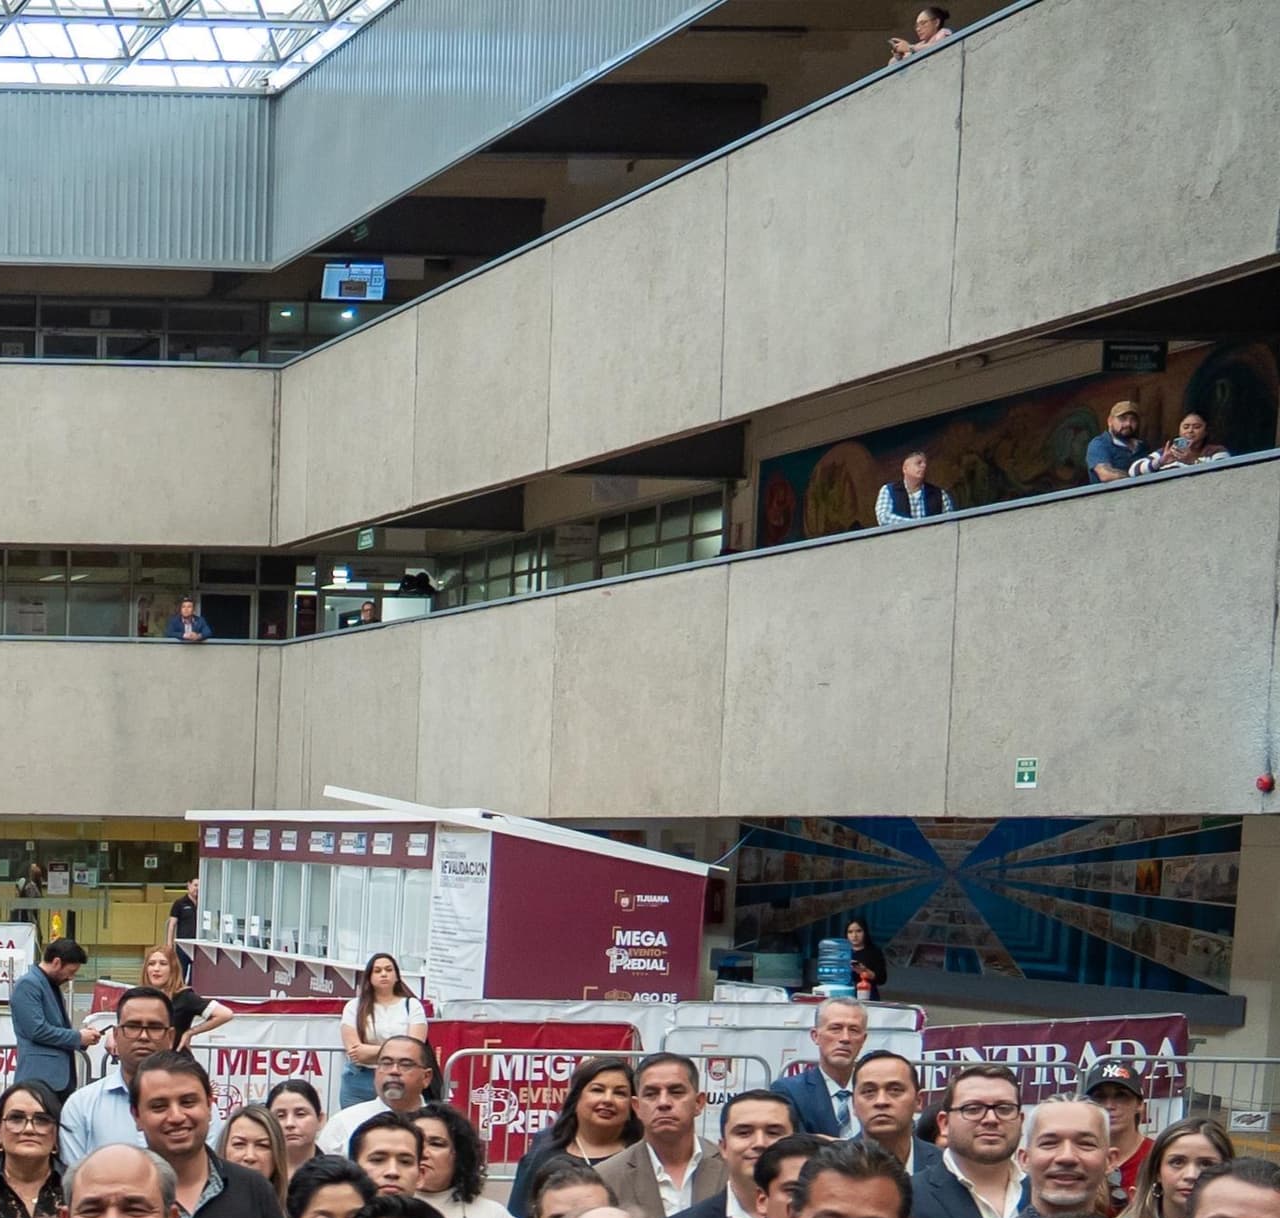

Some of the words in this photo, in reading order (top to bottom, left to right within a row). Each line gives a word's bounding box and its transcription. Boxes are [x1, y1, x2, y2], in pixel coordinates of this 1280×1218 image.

[616, 931, 668, 947] MEGA
[606, 946, 666, 973] PREDIAL
[628, 948, 662, 957] EVENTO
[662, 993, 678, 1003] DE
[216, 1048, 323, 1076] MEGA
